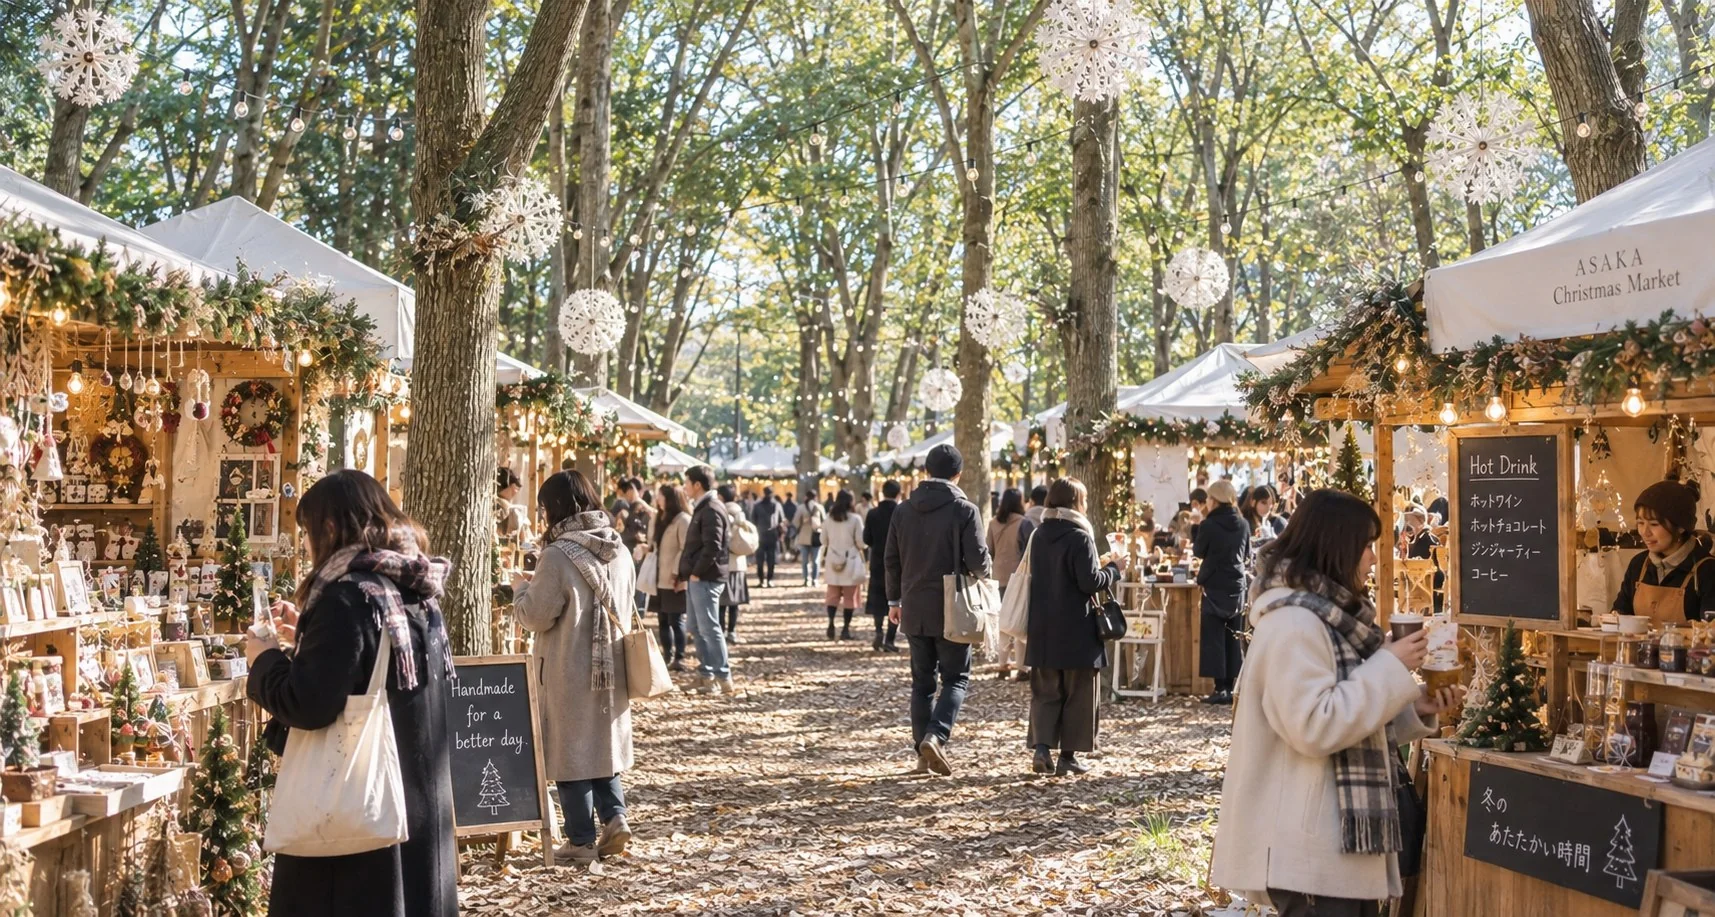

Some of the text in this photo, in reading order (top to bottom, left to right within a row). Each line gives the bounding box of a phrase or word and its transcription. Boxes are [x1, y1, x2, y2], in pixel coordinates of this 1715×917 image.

[1575, 248, 1644, 276] ASAKA
[1553, 269, 1681, 305] Christmas Market
[1470, 454, 1539, 475] Hot Drink
[1470, 493, 1523, 508] ホットワイン
[1470, 517, 1547, 535] ホットチョコレート
[1471, 542, 1541, 559] ジンジャーティー
[1471, 568, 1509, 581] コーヒー
[451, 677, 515, 697] Handmade
[466, 704, 502, 727] for a
[456, 729, 528, 754] better day.
[1480, 786, 1508, 813] 冬の
[1489, 821, 1591, 873] あたたかい時間
